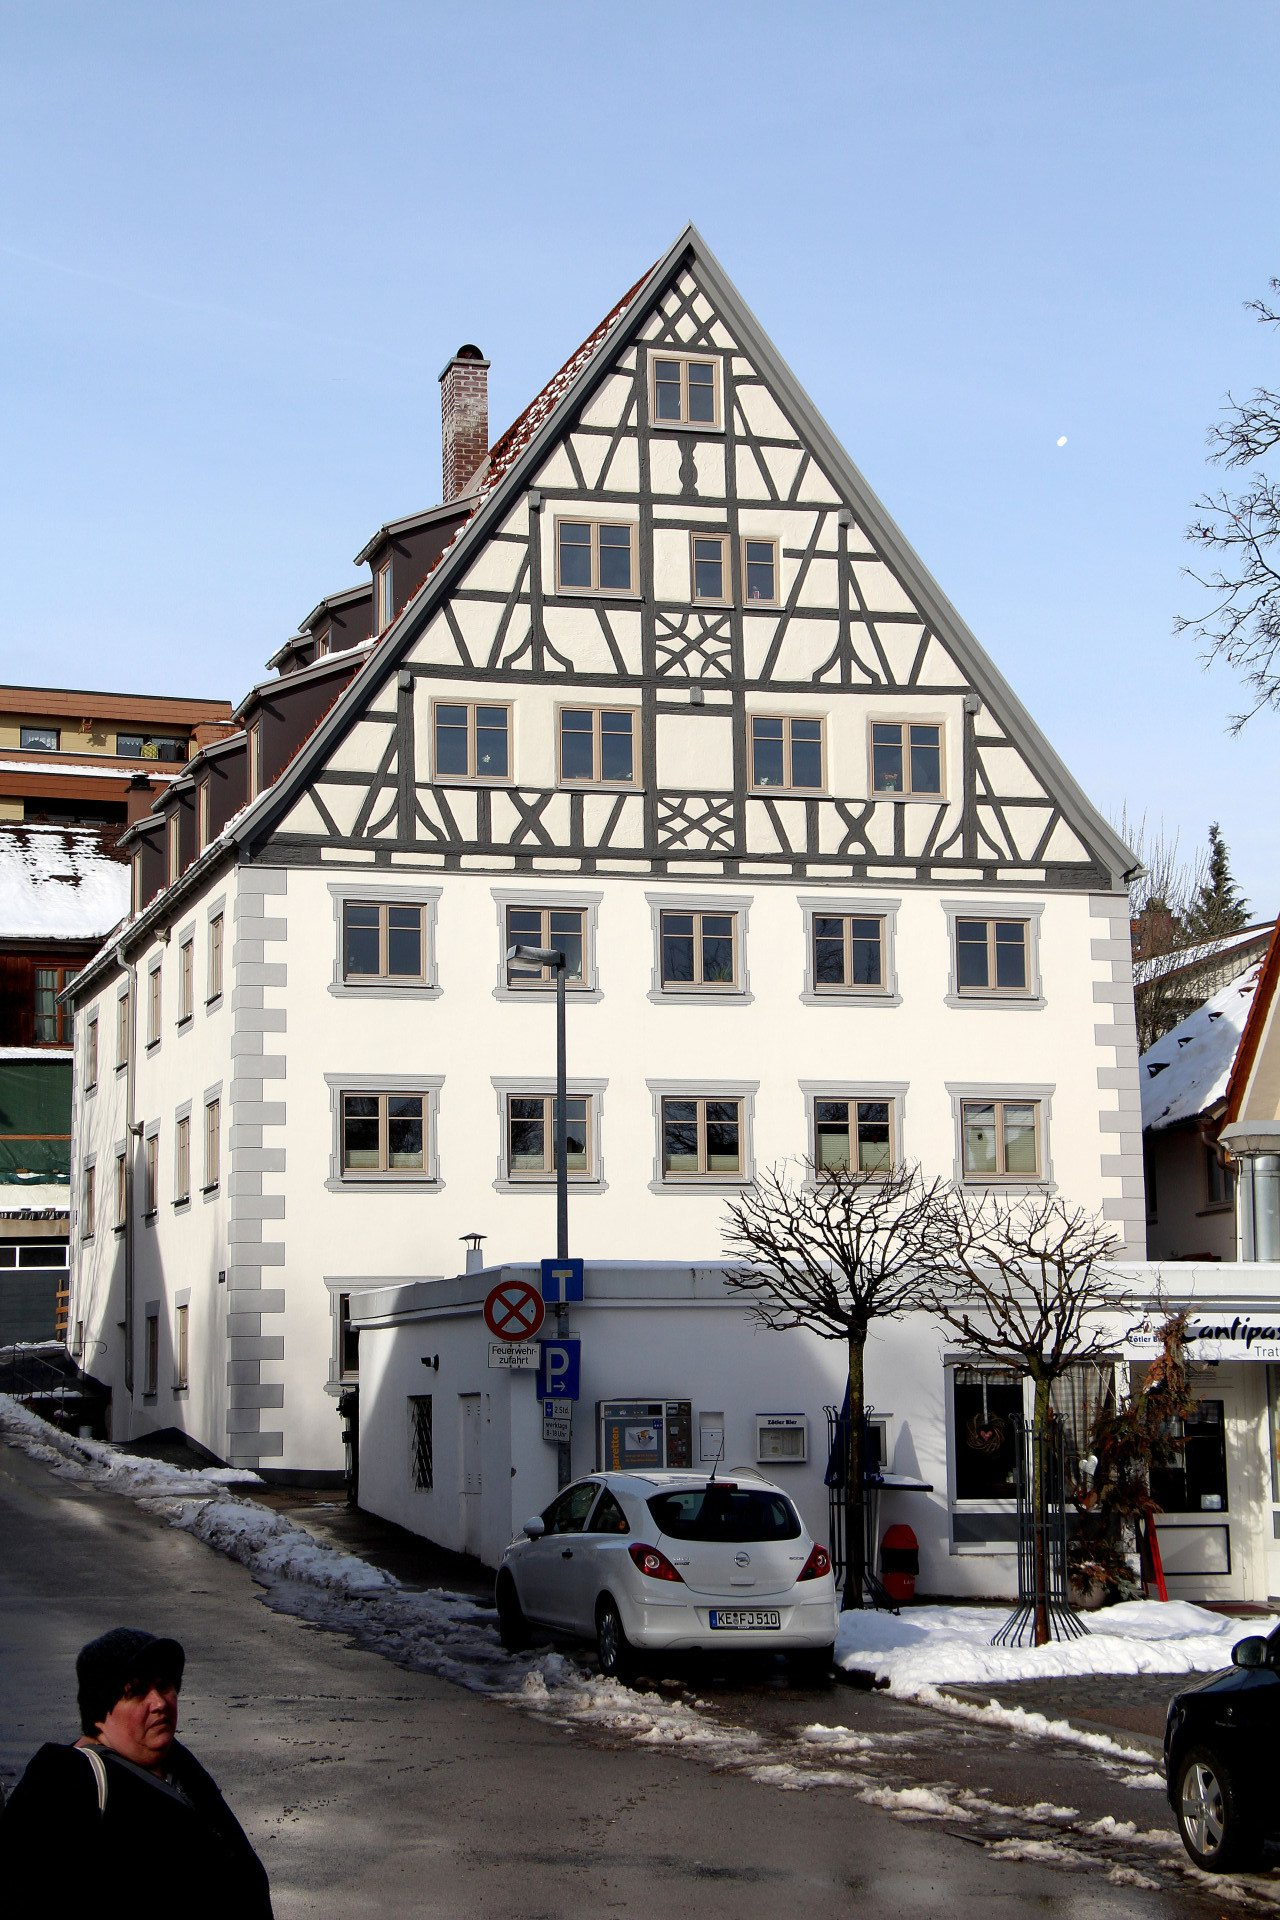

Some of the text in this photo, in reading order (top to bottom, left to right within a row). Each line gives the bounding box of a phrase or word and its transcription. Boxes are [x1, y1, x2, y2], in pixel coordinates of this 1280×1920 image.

[1129, 1335, 1151, 1343] Zötler
[491, 1345, 537, 1355] Feuerwehr-
[1254, 1346, 1280, 1357] Trat
[499, 1355, 529, 1365] zufahrt
[545, 1347, 570, 1393] P
[554, 1406, 570, 1414] 2 Std.
[545, 1422, 568, 1430] werktags
[718, 1613, 732, 1625] KE
